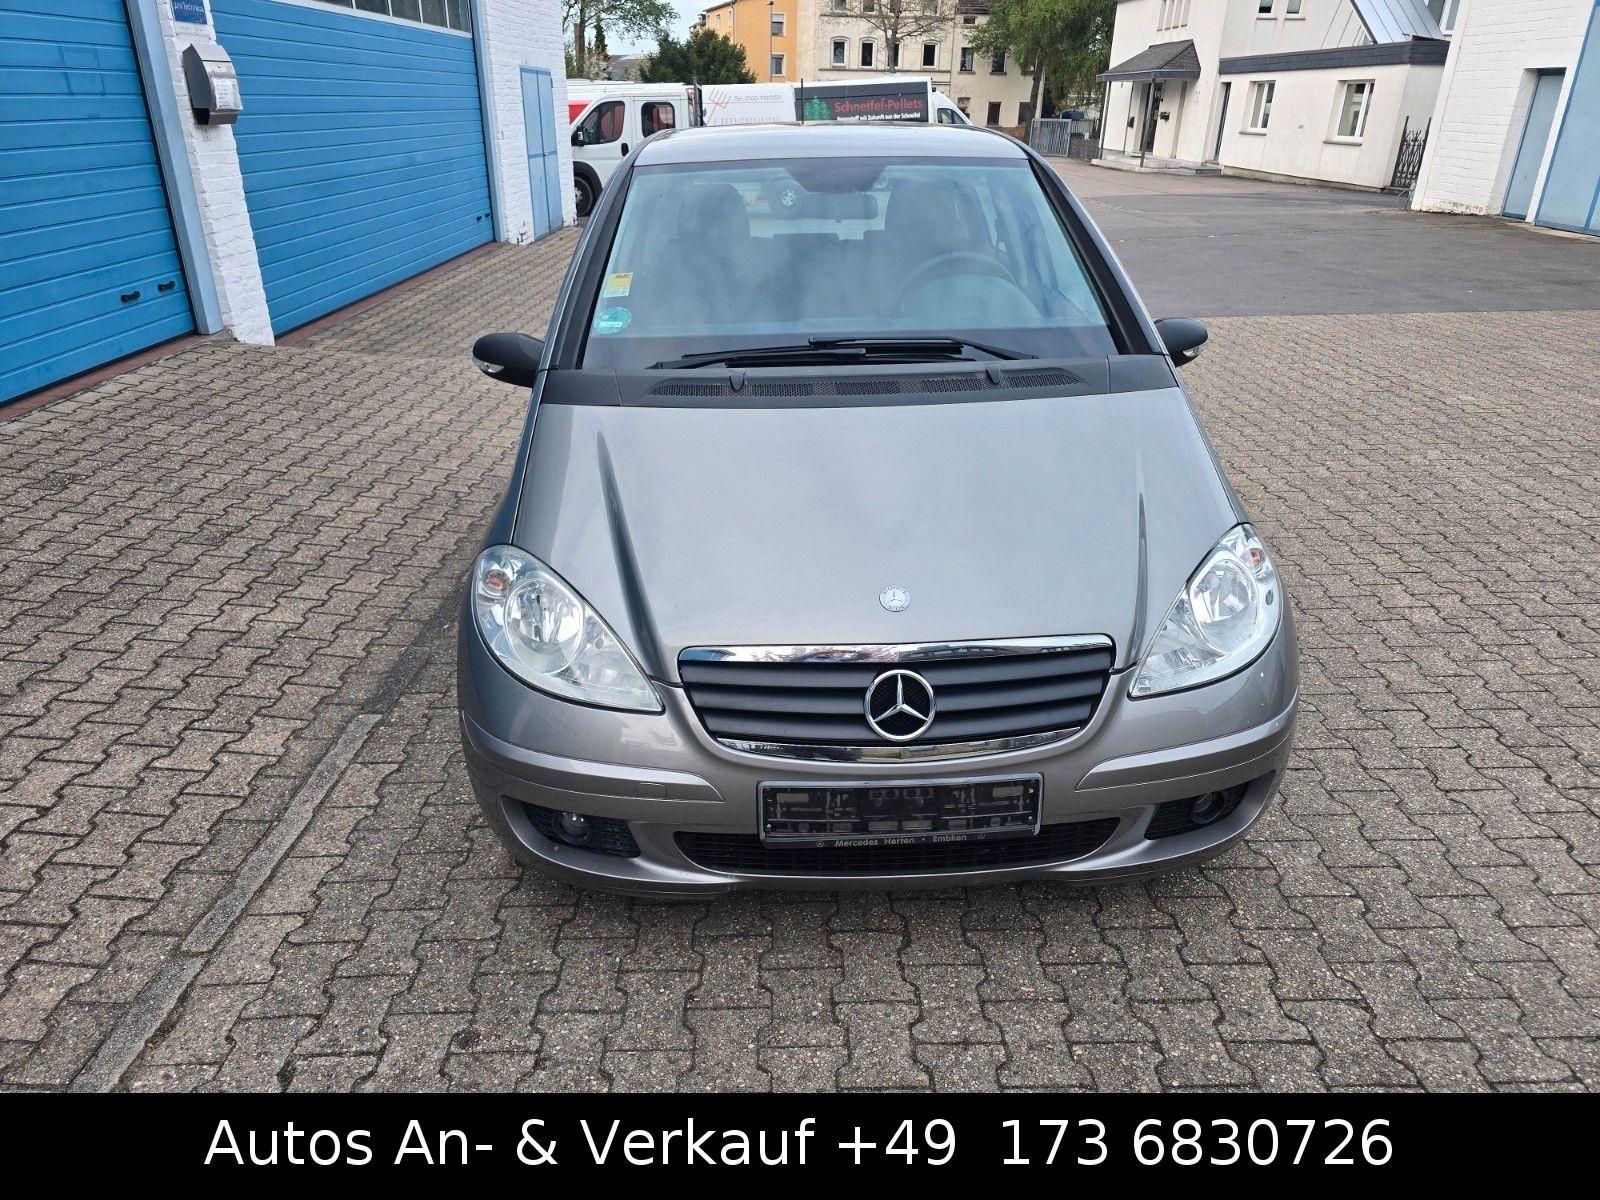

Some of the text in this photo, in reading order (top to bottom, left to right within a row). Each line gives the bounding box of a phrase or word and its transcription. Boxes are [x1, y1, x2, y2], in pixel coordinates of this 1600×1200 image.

[834, 97, 923, 112] Schneifel-Pellets
[835, 838, 879, 848] Mercedes
[932, 834, 967, 843] Embken
